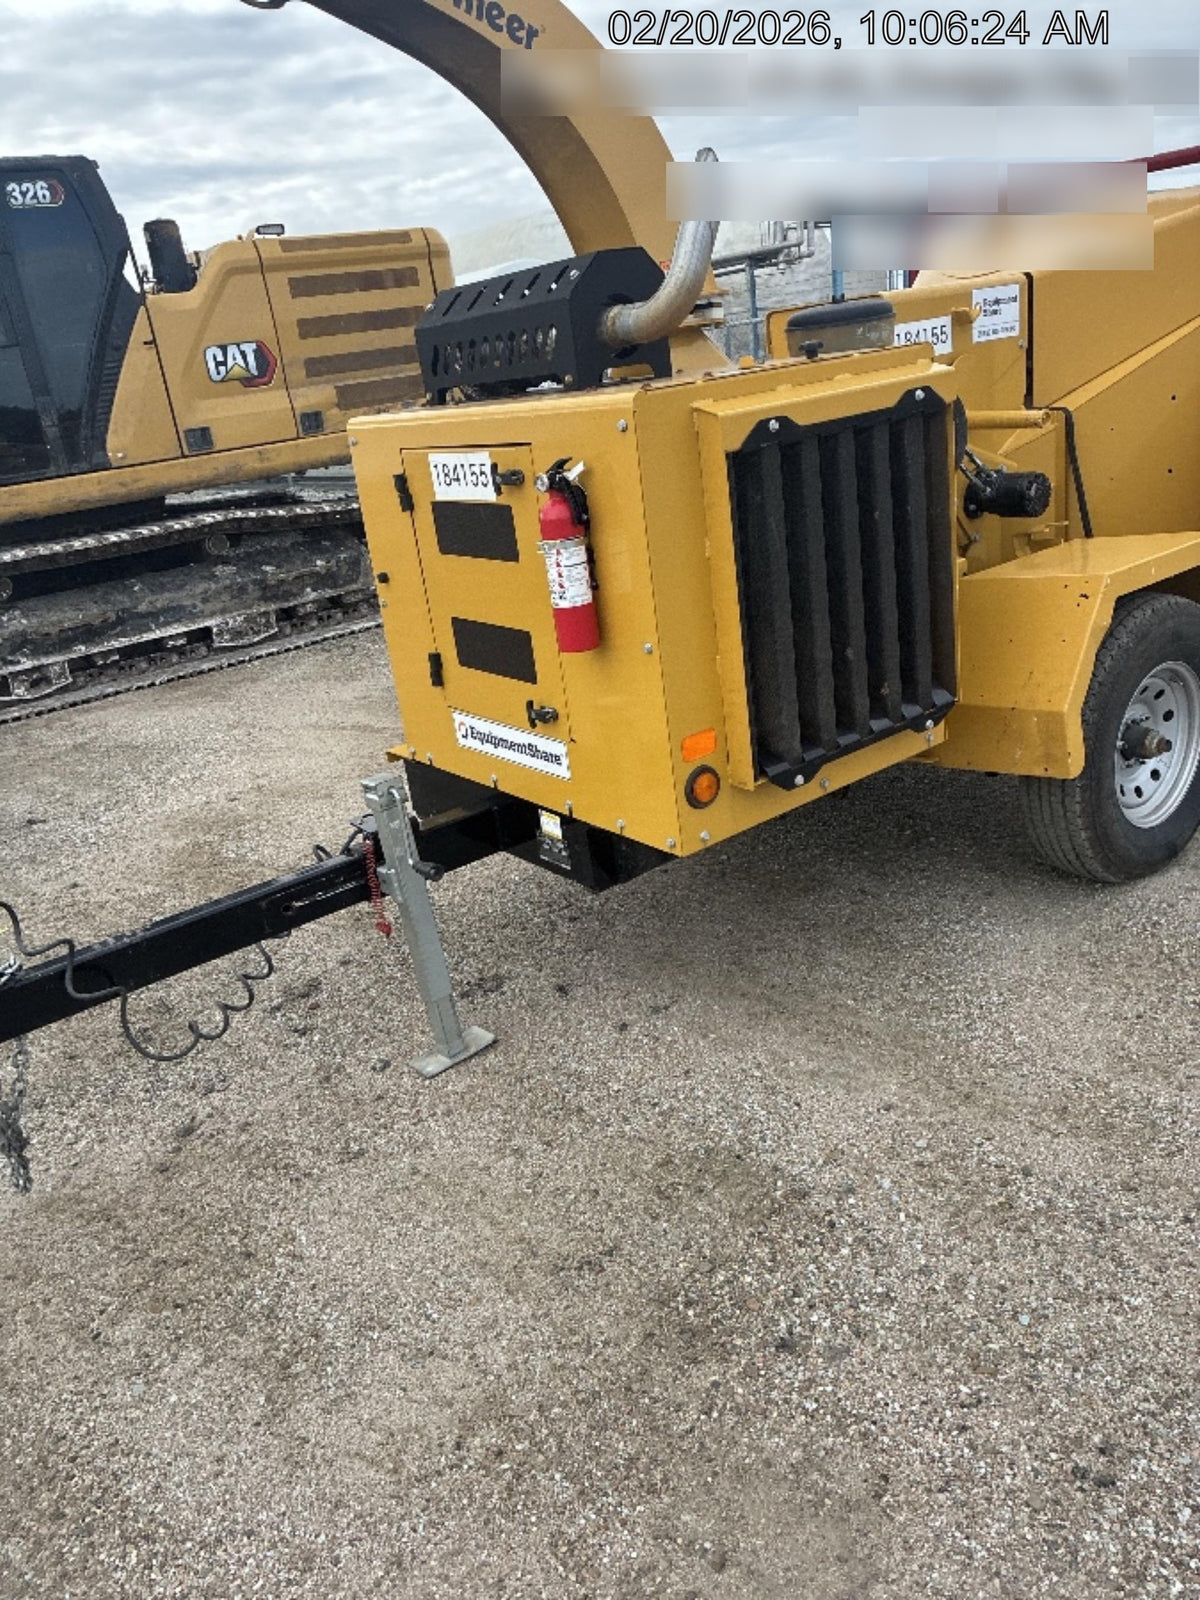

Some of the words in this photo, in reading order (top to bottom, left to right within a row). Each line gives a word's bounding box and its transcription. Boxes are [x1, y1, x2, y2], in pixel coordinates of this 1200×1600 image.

[6, 180, 51, 206] 326
[204, 341, 258, 382] CAT
[433, 463, 489, 488] 184155
